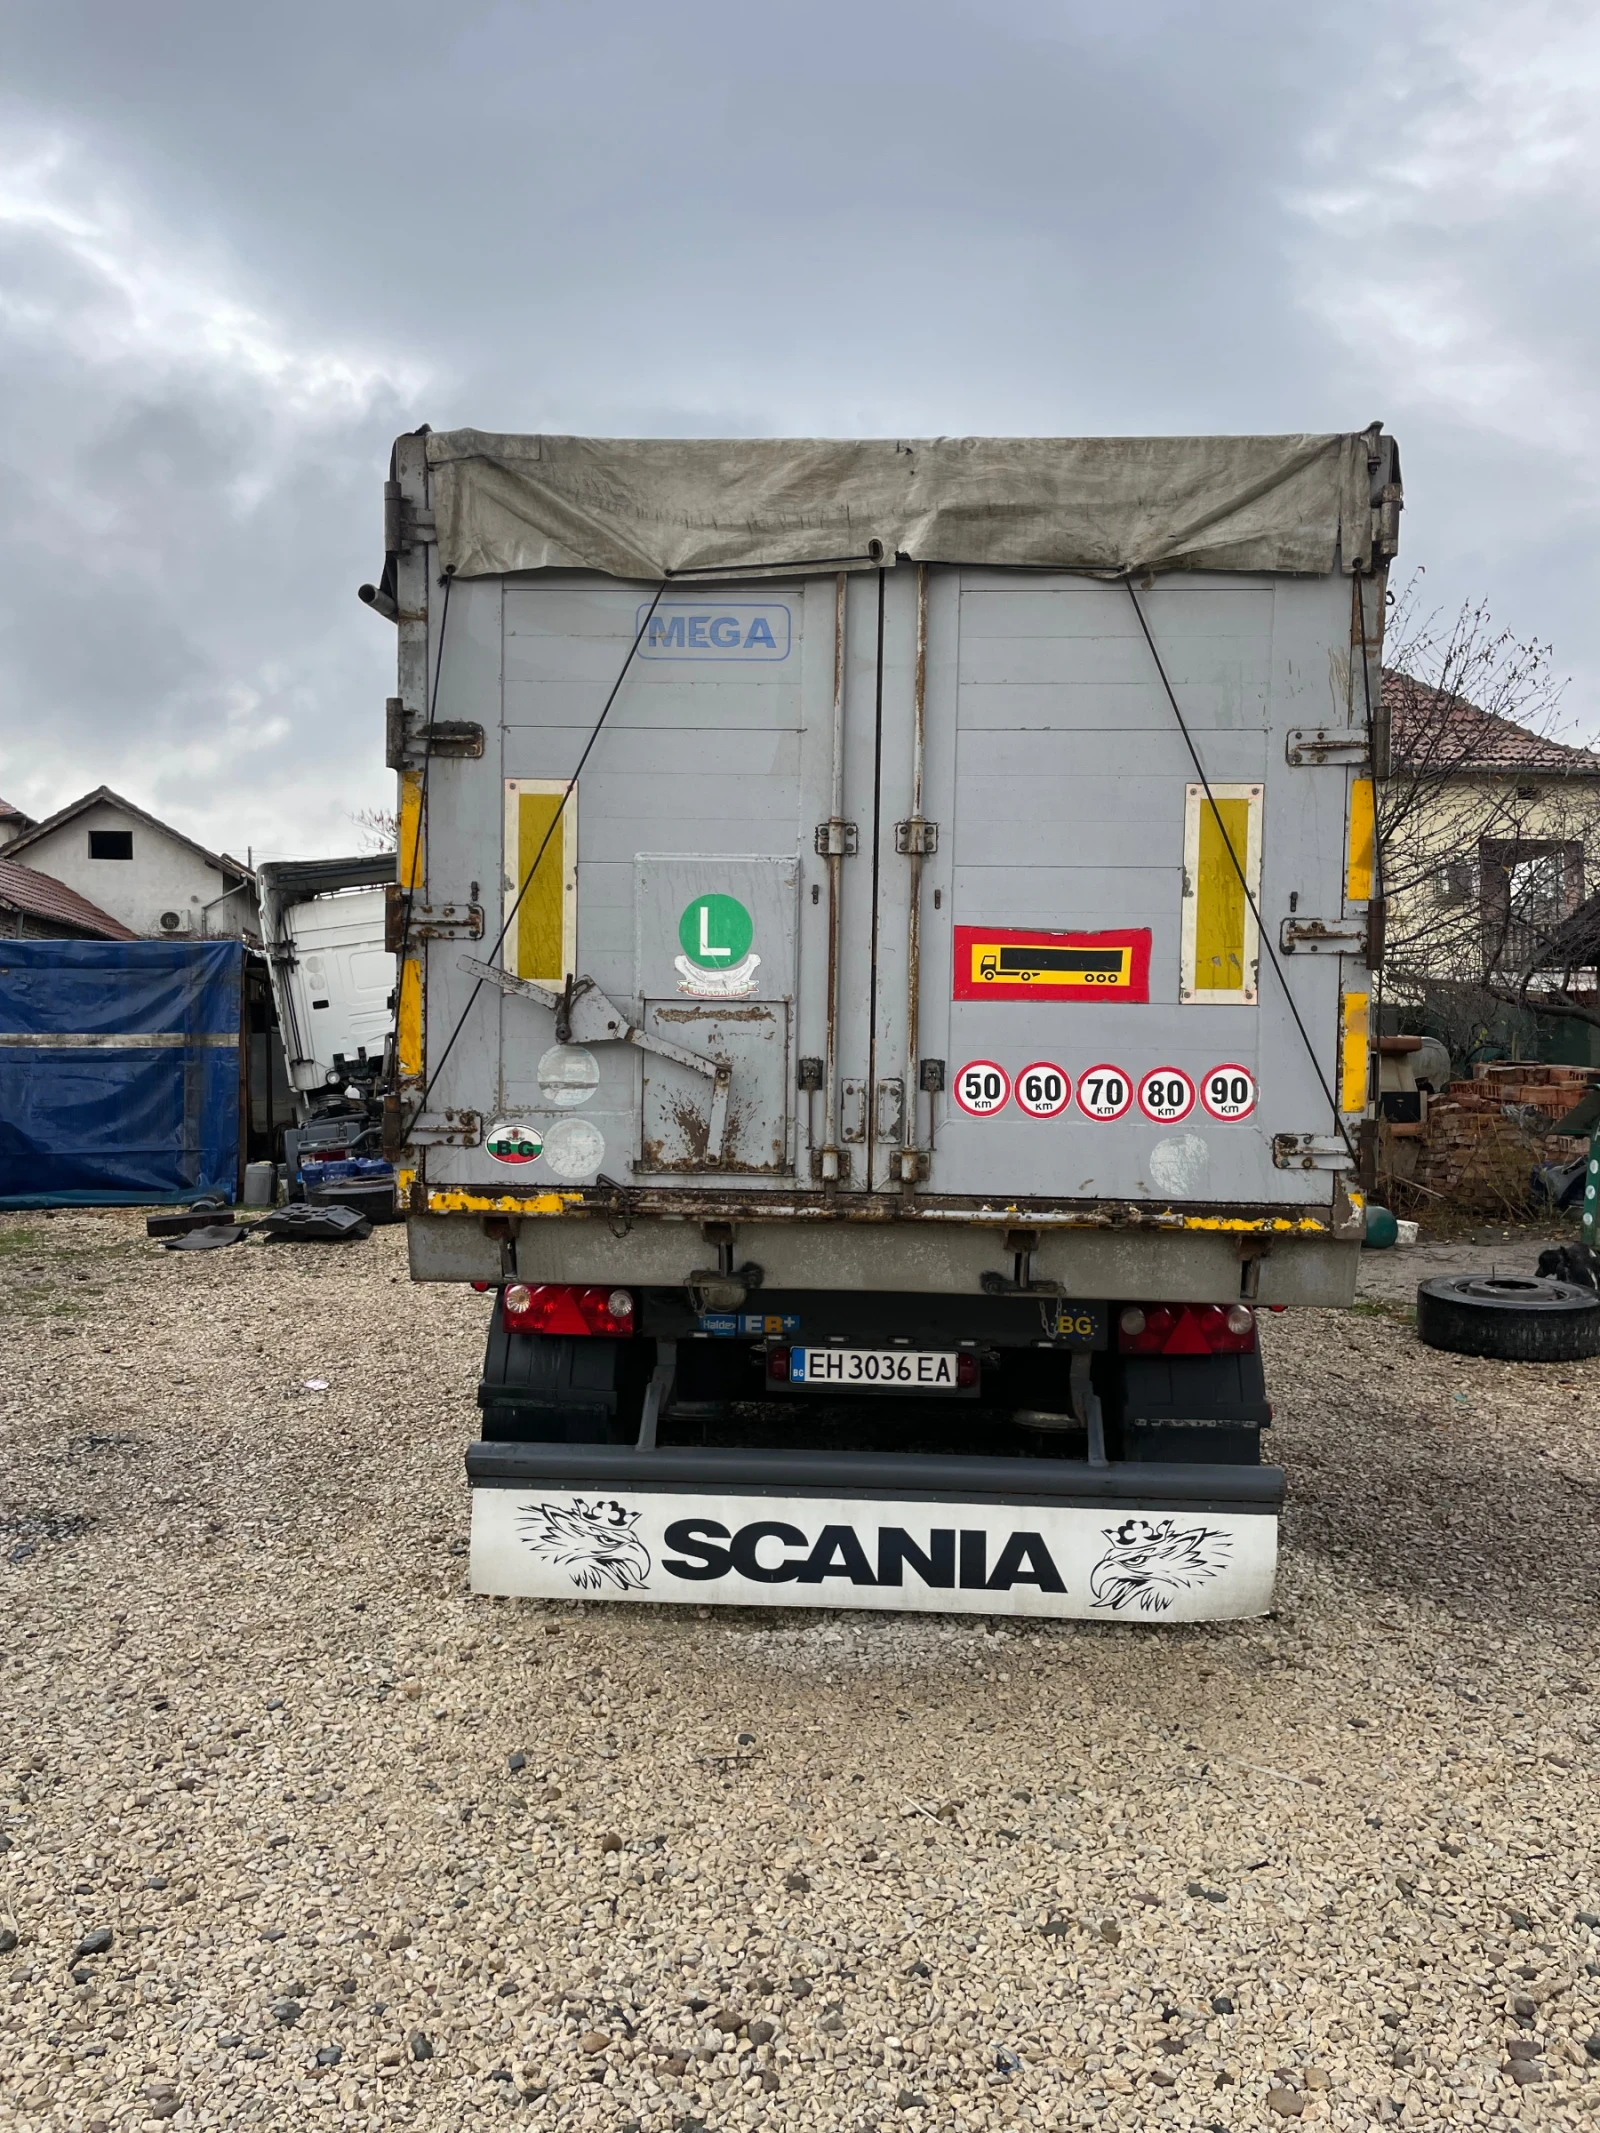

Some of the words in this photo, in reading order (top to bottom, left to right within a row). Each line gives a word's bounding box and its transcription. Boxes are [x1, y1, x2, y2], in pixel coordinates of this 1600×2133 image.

[649, 616, 777, 649] MEGA
[699, 906, 732, 956] L
[692, 986, 743, 997] BULGARIA
[965, 1073, 1001, 1100] 50
[1025, 1075, 1062, 1102] 60
[1087, 1078, 1124, 1106] 70
[1147, 1080, 1184, 1107] 80
[1211, 1077, 1248, 1104] 90
[496, 1140, 534, 1158] BG
[703, 1319, 736, 1330] Haldex
[1057, 1315, 1092, 1335] BG
[793, 1368, 804, 1377] BG
[662, 1518, 1068, 1594] SCANIA
